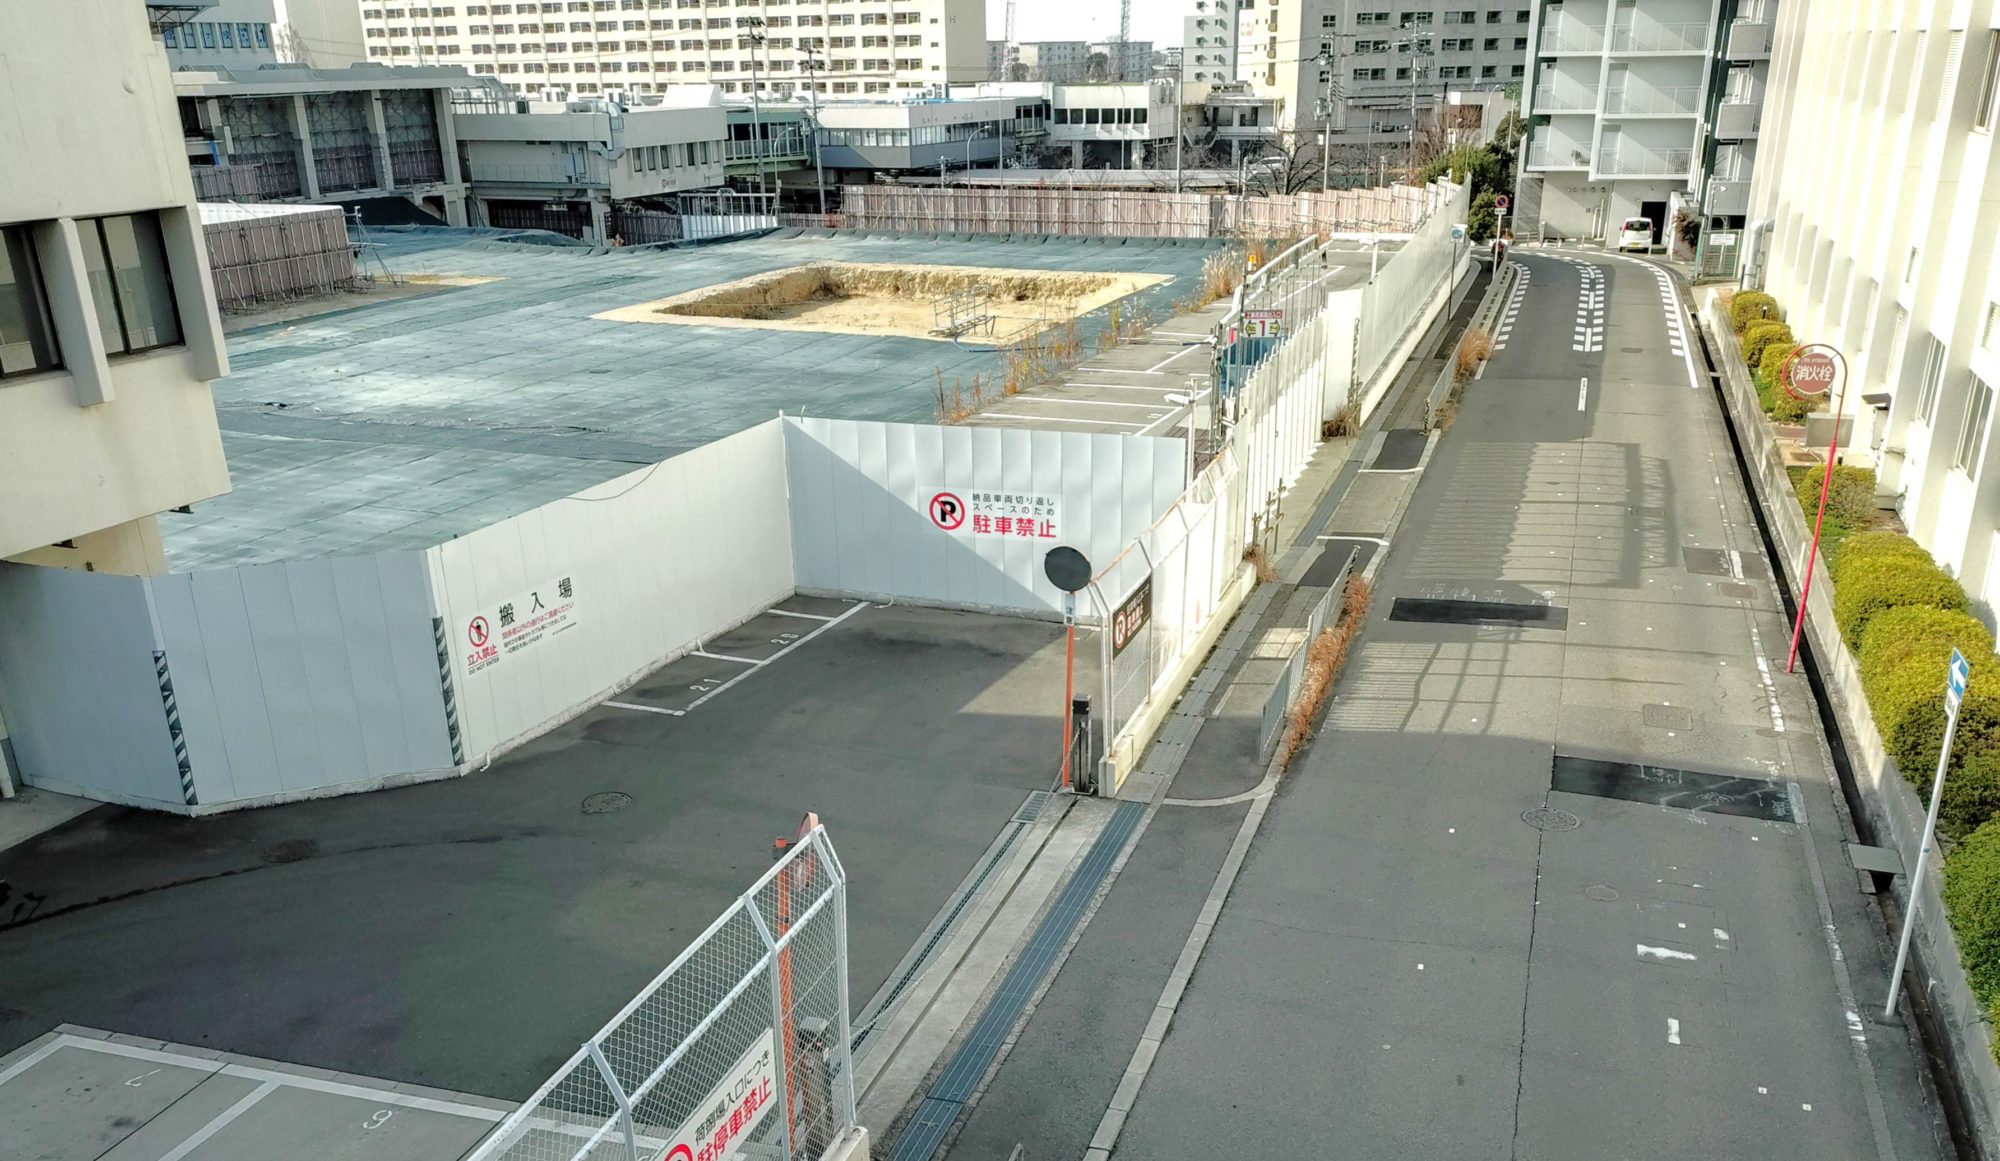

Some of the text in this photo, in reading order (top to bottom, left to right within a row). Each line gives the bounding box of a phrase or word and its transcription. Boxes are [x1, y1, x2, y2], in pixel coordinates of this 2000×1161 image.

[1796, 365, 1833, 381] 消火栓
[972, 493, 1055, 506] 納品車両切り返し
[973, 503, 1055, 516] スペースのため
[973, 514, 1057, 538] 駐車禁止
[499, 577, 572, 628] 搬入場
[467, 643, 498, 666] 立入禁止
[476, 663, 486, 672] NOT
[486, 656, 500, 667] ENTER
[689, 678, 722, 693] 21
